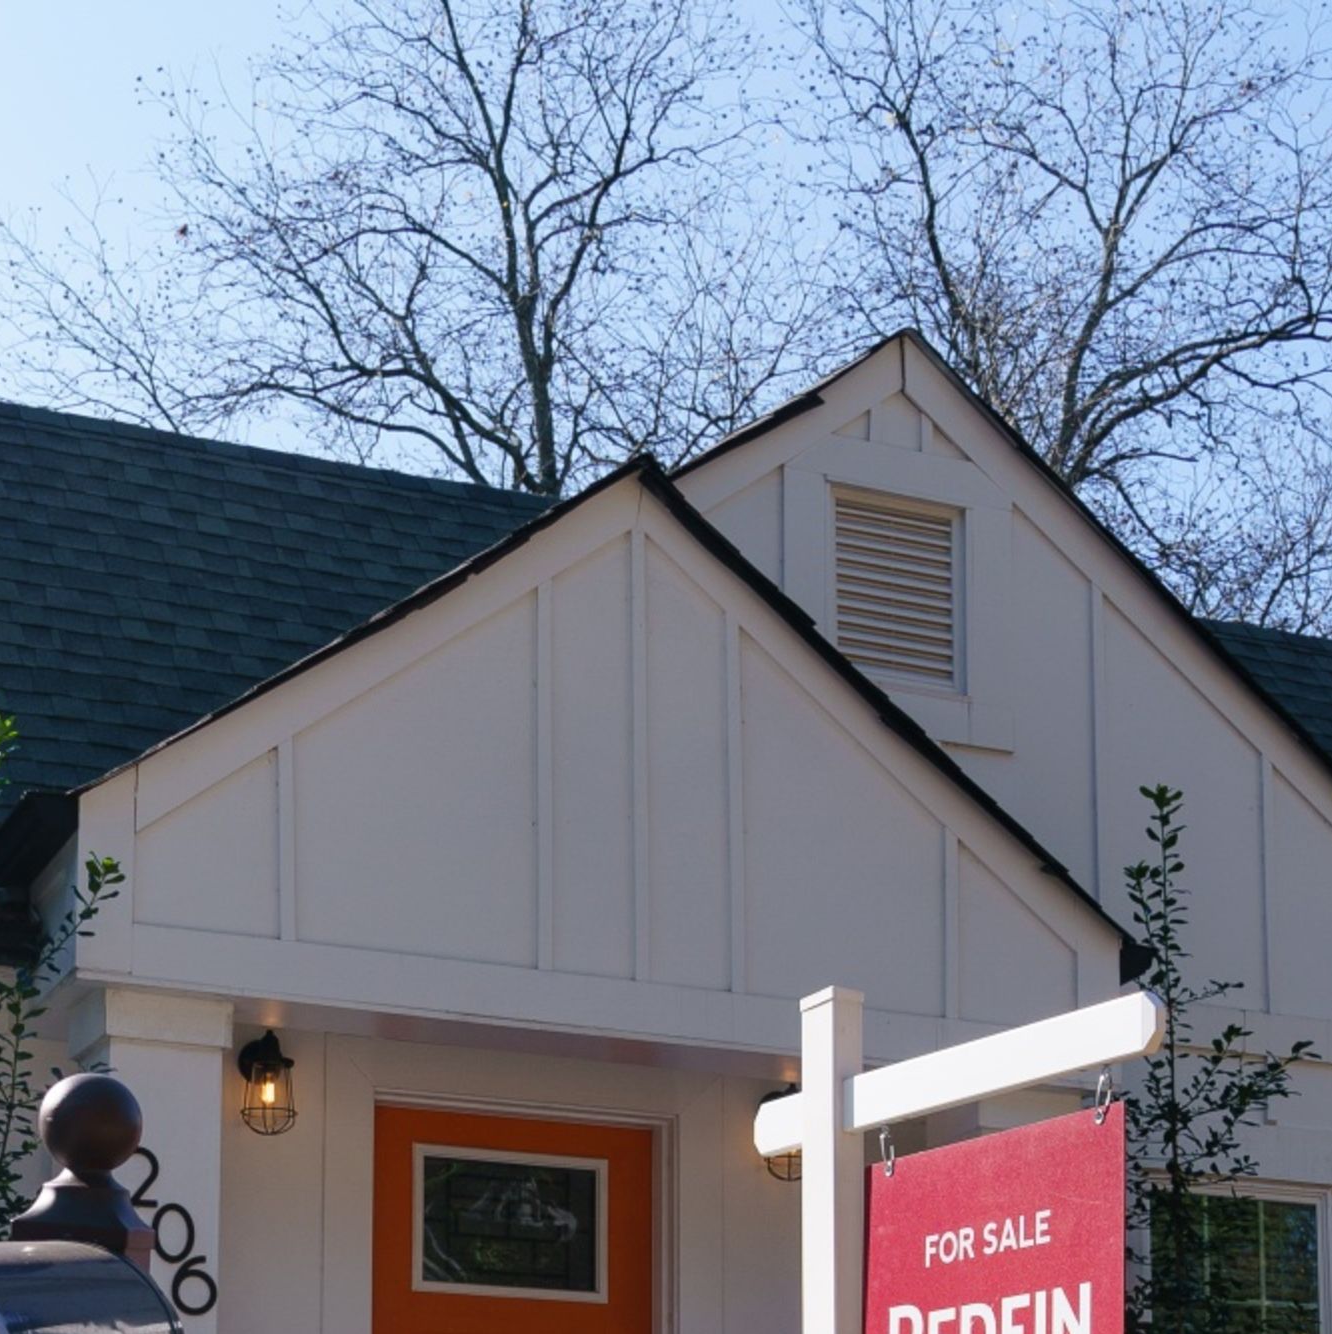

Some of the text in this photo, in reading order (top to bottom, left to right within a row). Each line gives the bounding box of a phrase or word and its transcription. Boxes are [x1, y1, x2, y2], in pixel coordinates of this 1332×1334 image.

[131, 1146, 217, 1315] 206
[925, 1209, 1051, 1268] FOR SALE
